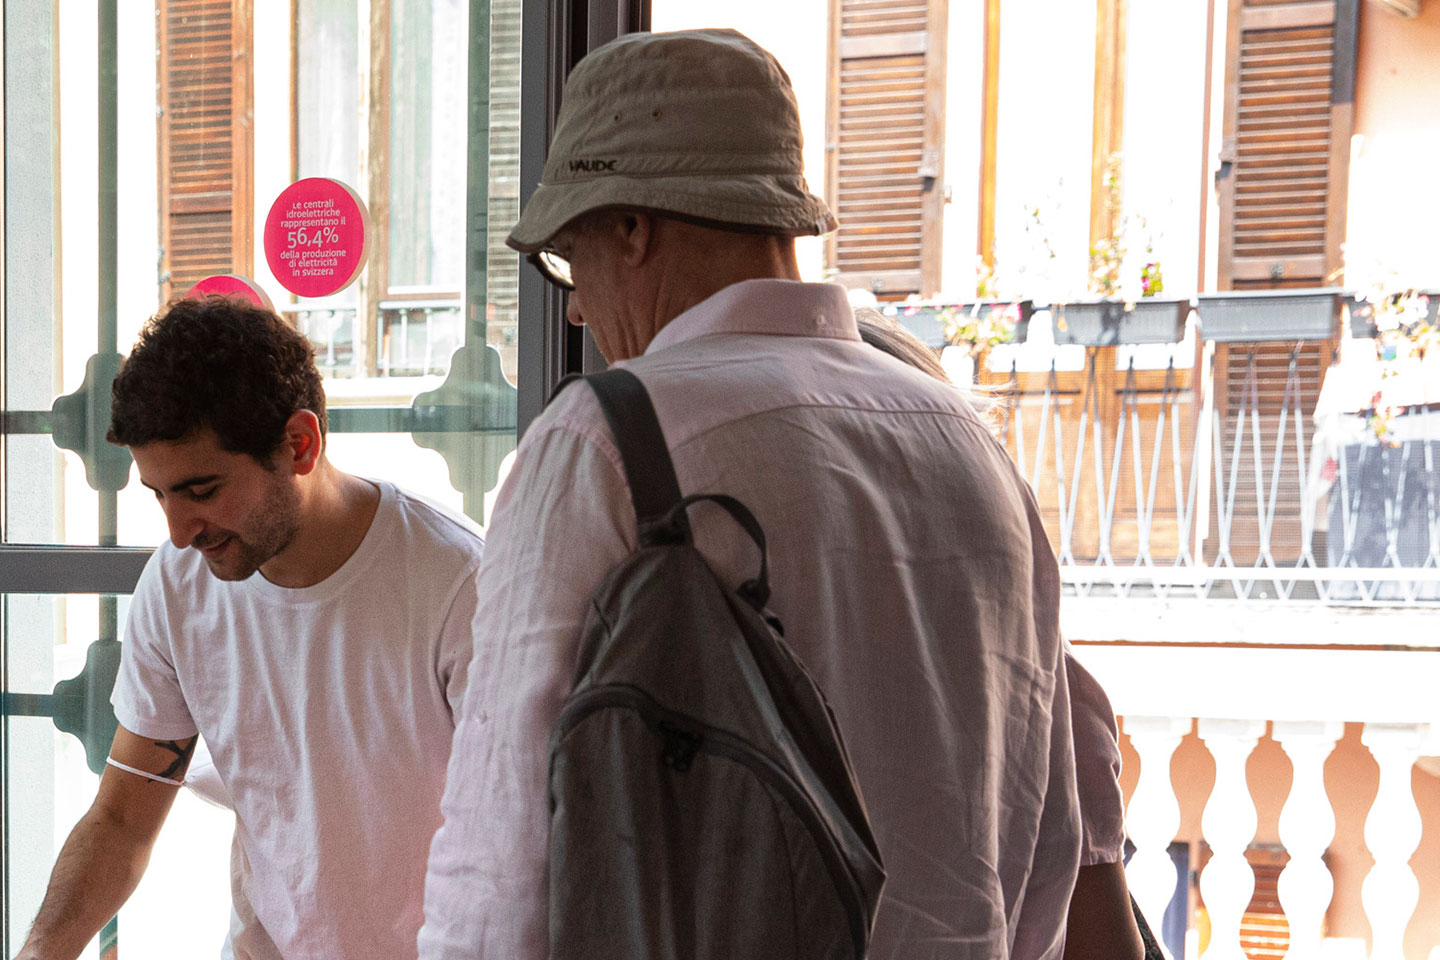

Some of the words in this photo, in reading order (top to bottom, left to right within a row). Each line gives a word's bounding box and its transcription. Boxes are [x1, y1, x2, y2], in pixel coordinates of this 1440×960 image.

[569, 159, 617, 173] VAUDE
[303, 199, 334, 209] centrali
[286, 208, 340, 218] idroelettriche
[280, 218, 338, 229] rappresentano
[340, 216, 346, 226] il
[287, 226, 339, 249] 56,4%
[280, 250, 299, 259] della
[302, 249, 346, 260] produzione
[289, 259, 296, 267] di
[292, 268, 300, 276] in
